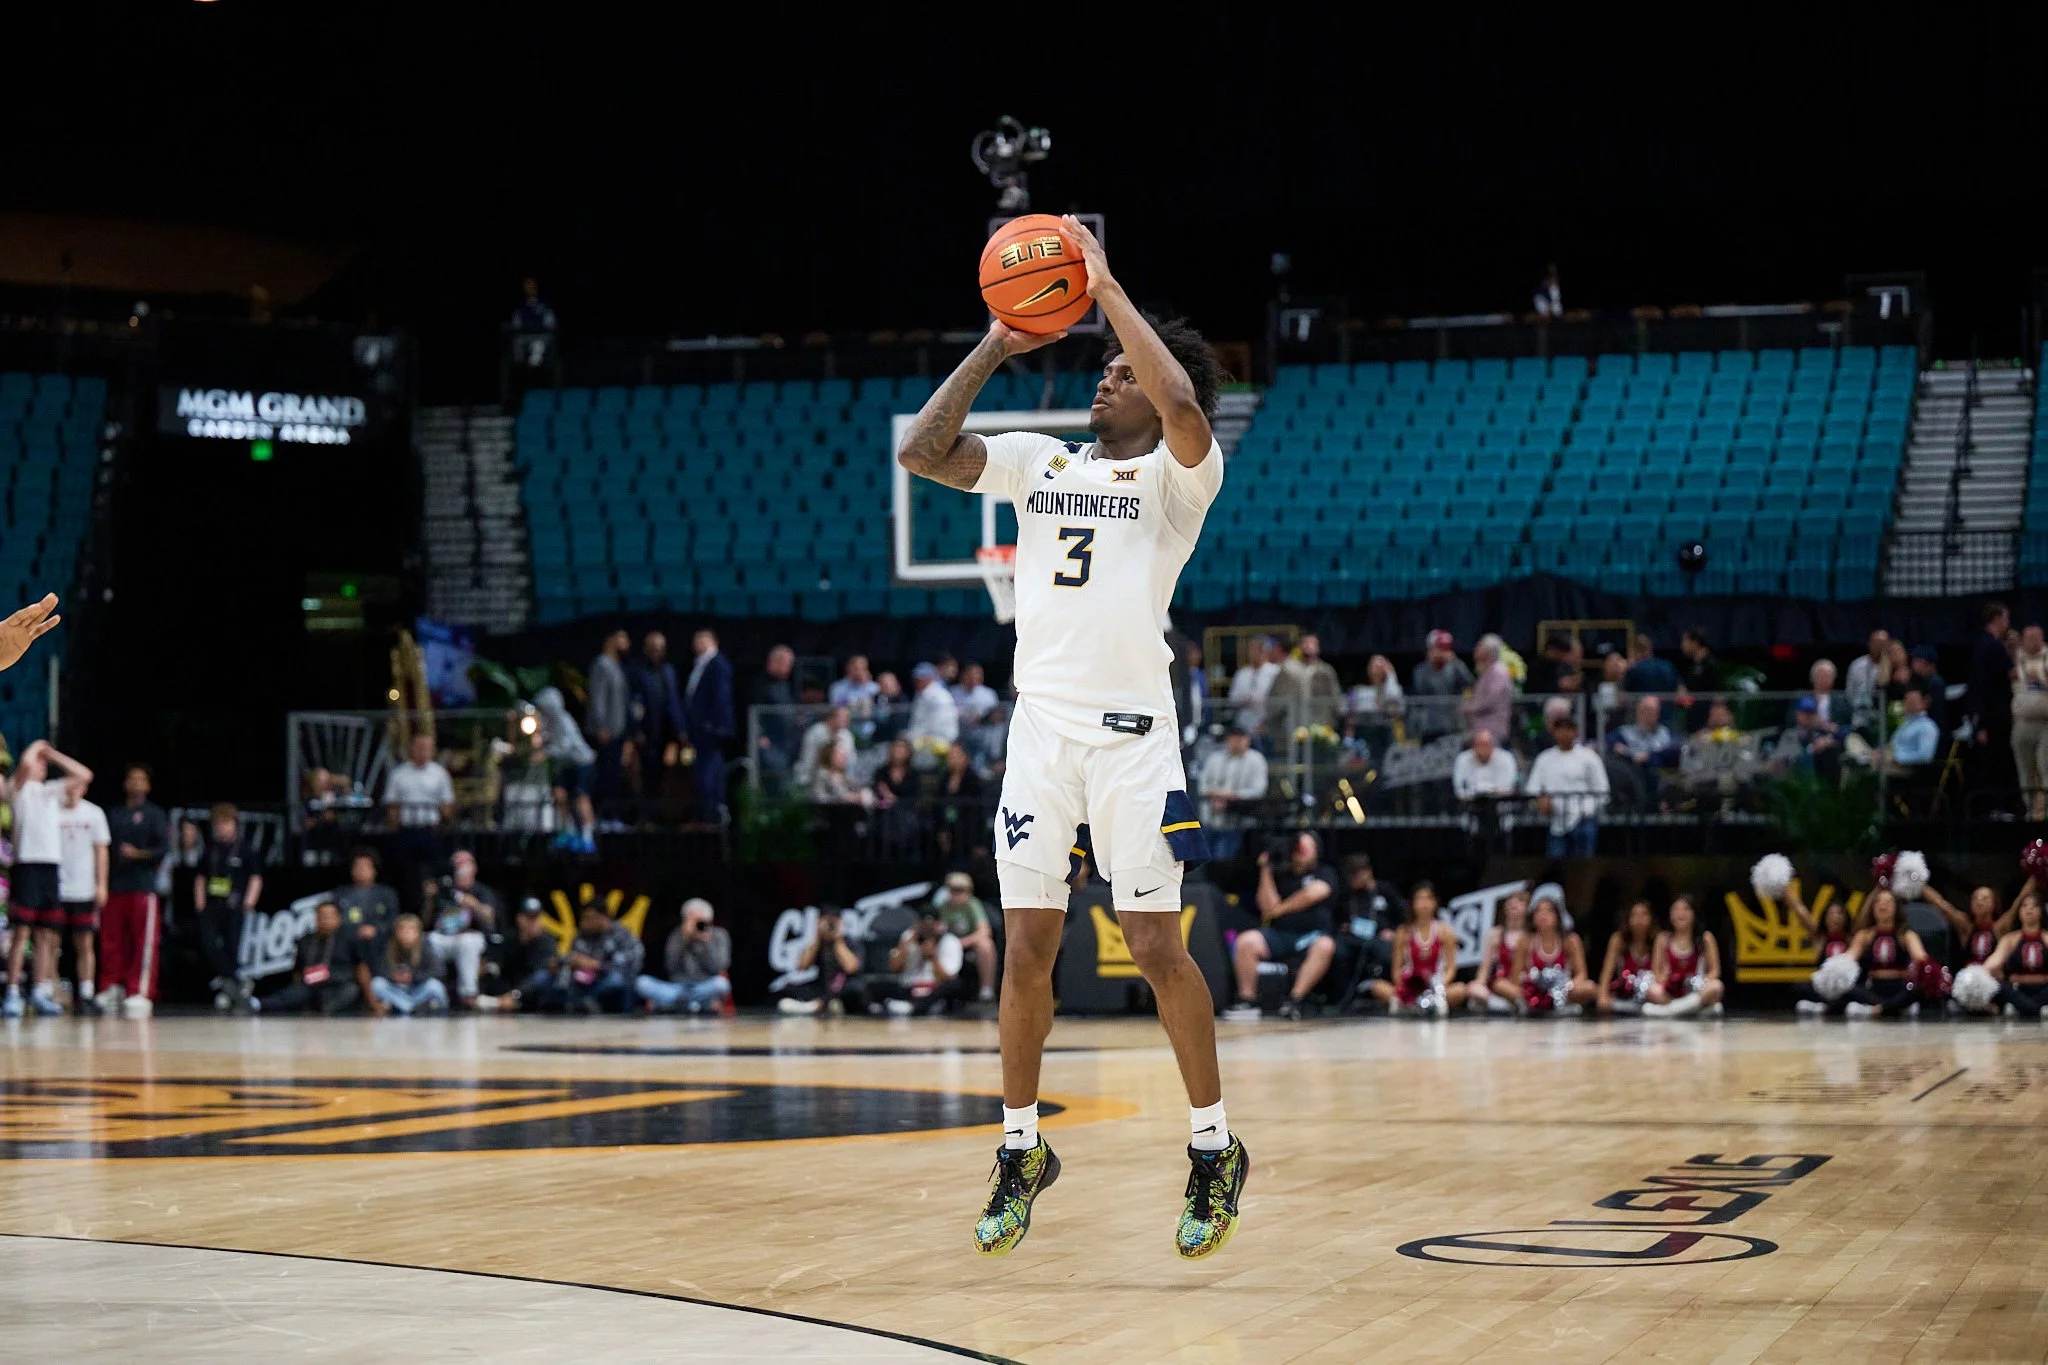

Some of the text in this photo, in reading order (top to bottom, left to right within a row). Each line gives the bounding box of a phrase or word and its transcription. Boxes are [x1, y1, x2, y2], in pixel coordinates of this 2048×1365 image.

[1000, 241, 1063, 270] ELITE
[176, 388, 367, 427] MGM GRAND
[1026, 491, 1140, 520] MOUNTAINEERS
[1053, 526, 1096, 588] 3
[1549, 1152, 1834, 1226] LEXUS
